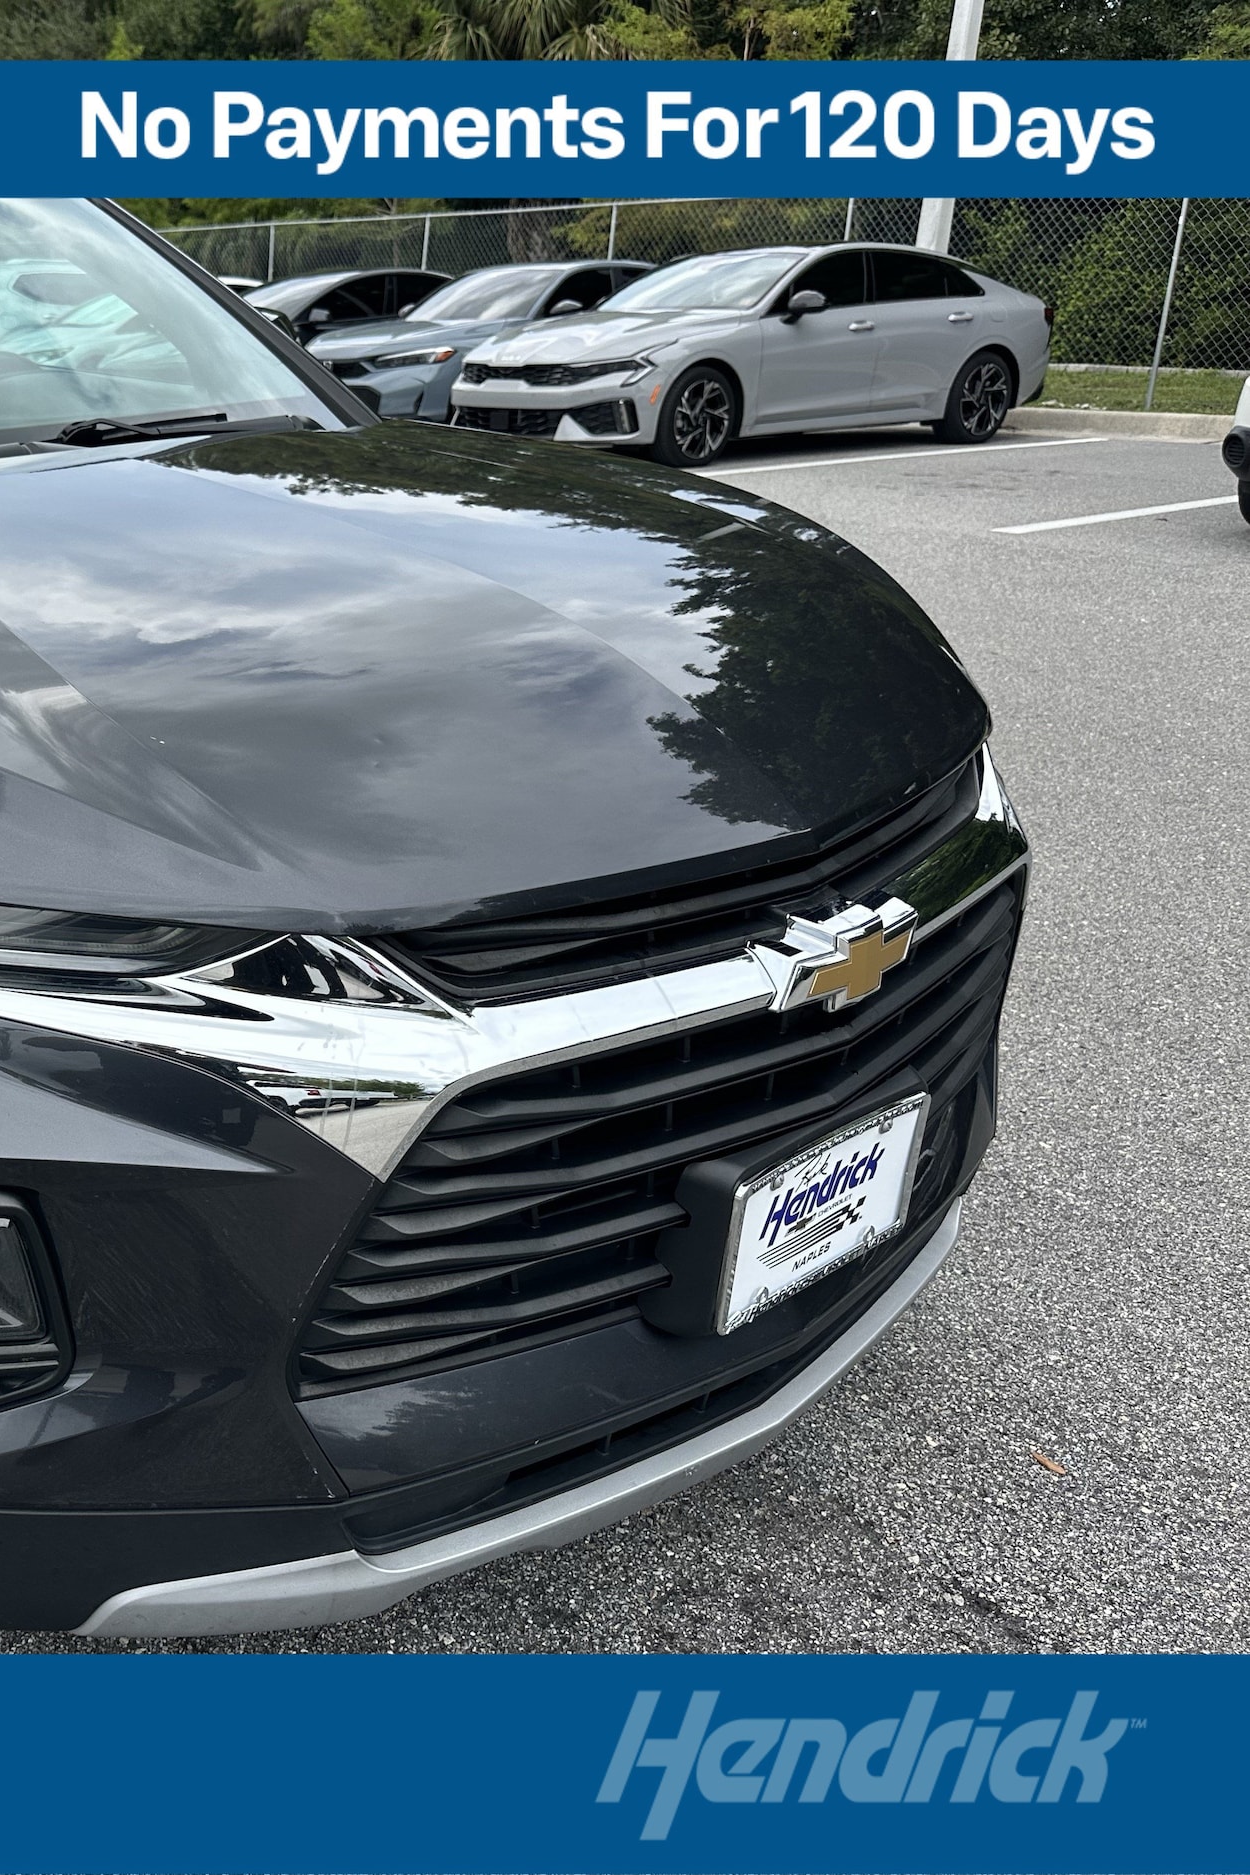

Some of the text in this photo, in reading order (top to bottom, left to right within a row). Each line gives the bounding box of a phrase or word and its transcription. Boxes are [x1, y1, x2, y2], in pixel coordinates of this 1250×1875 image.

[759, 1142, 885, 1248] Hendrick
[817, 1194, 853, 1218] CHEVROLET
[791, 1241, 832, 1273] NAPLES
